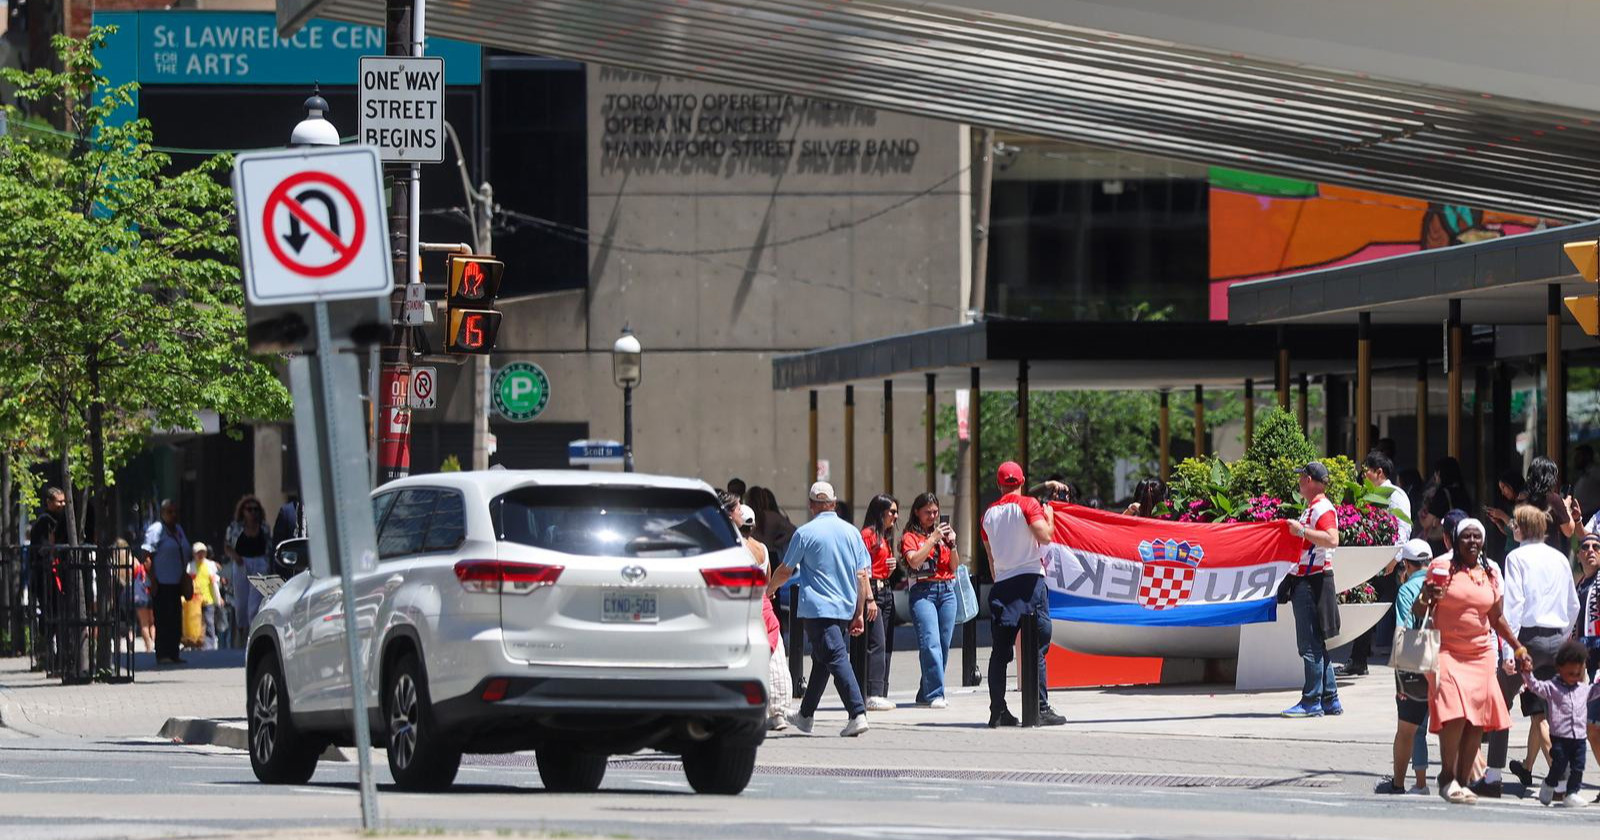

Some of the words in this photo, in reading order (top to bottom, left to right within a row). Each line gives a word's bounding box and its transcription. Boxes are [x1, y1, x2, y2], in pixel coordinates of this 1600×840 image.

[185, 25, 323, 49] LAWRENCE
[154, 52, 177, 63] FOR
[186, 54, 249, 75] ARTS
[156, 64, 177, 74] THE
[364, 71, 399, 90] ONE
[405, 71, 440, 91] WAY
[365, 100, 437, 119] STREET
[606, 94, 697, 111] TORONTO
[703, 93, 795, 110] OPERETTA
[605, 117, 668, 134] OPERA
[673, 117, 692, 134] IN
[698, 117, 784, 134] CONCERT
[366, 129, 436, 148] BEGINS
[606, 140, 726, 158] HANNAFORD
[732, 140, 796, 158] STREET
[801, 139, 862, 157] SILVER
[866, 139, 920, 157] BAND
[465, 315, 482, 347] 15
[511, 377, 532, 400] P
